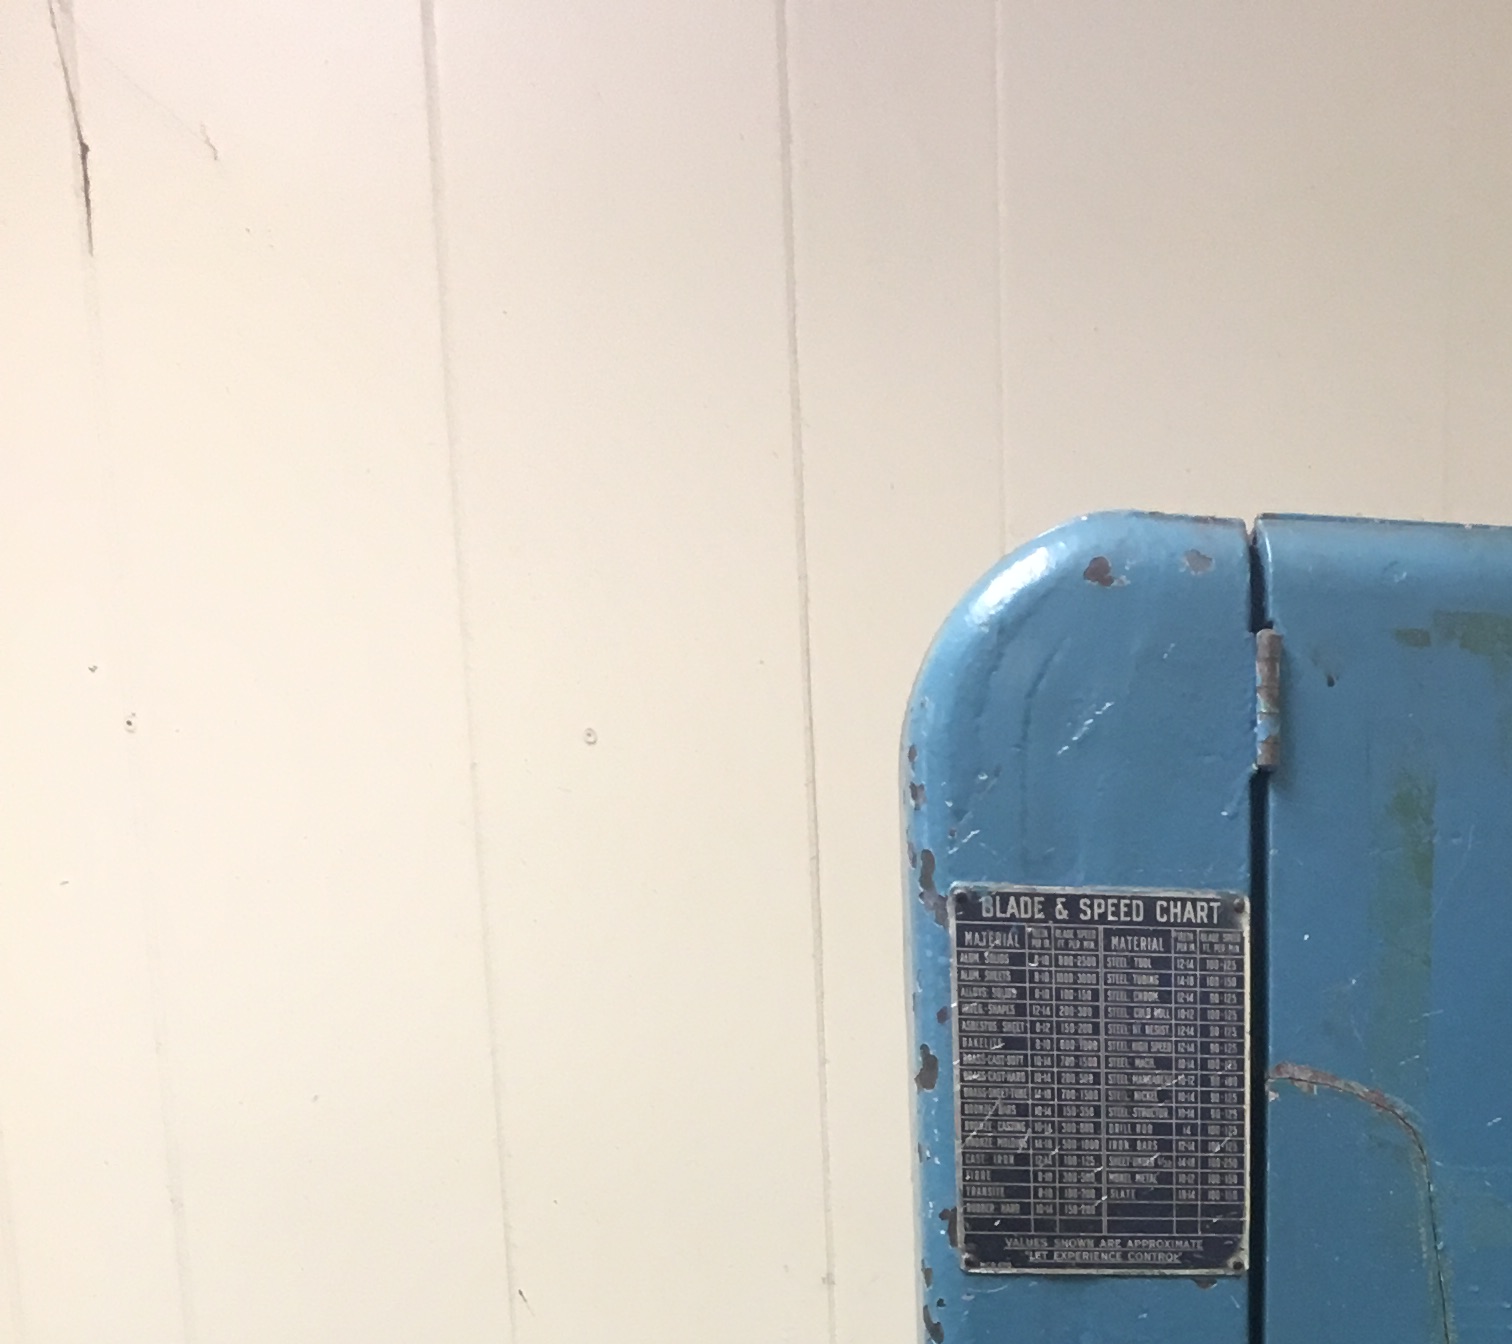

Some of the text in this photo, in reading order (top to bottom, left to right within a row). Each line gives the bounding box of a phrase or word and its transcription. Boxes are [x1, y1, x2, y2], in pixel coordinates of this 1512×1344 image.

[979, 896, 1221, 924] BLADE & SPEED CHART
[1111, 936, 1164, 951] MATERIAL
[1005, 1238, 1203, 1250] VALUES SHOWN ARE APPROXIMATE
[1054, 1251, 1122, 1261] EXPERIENCE
